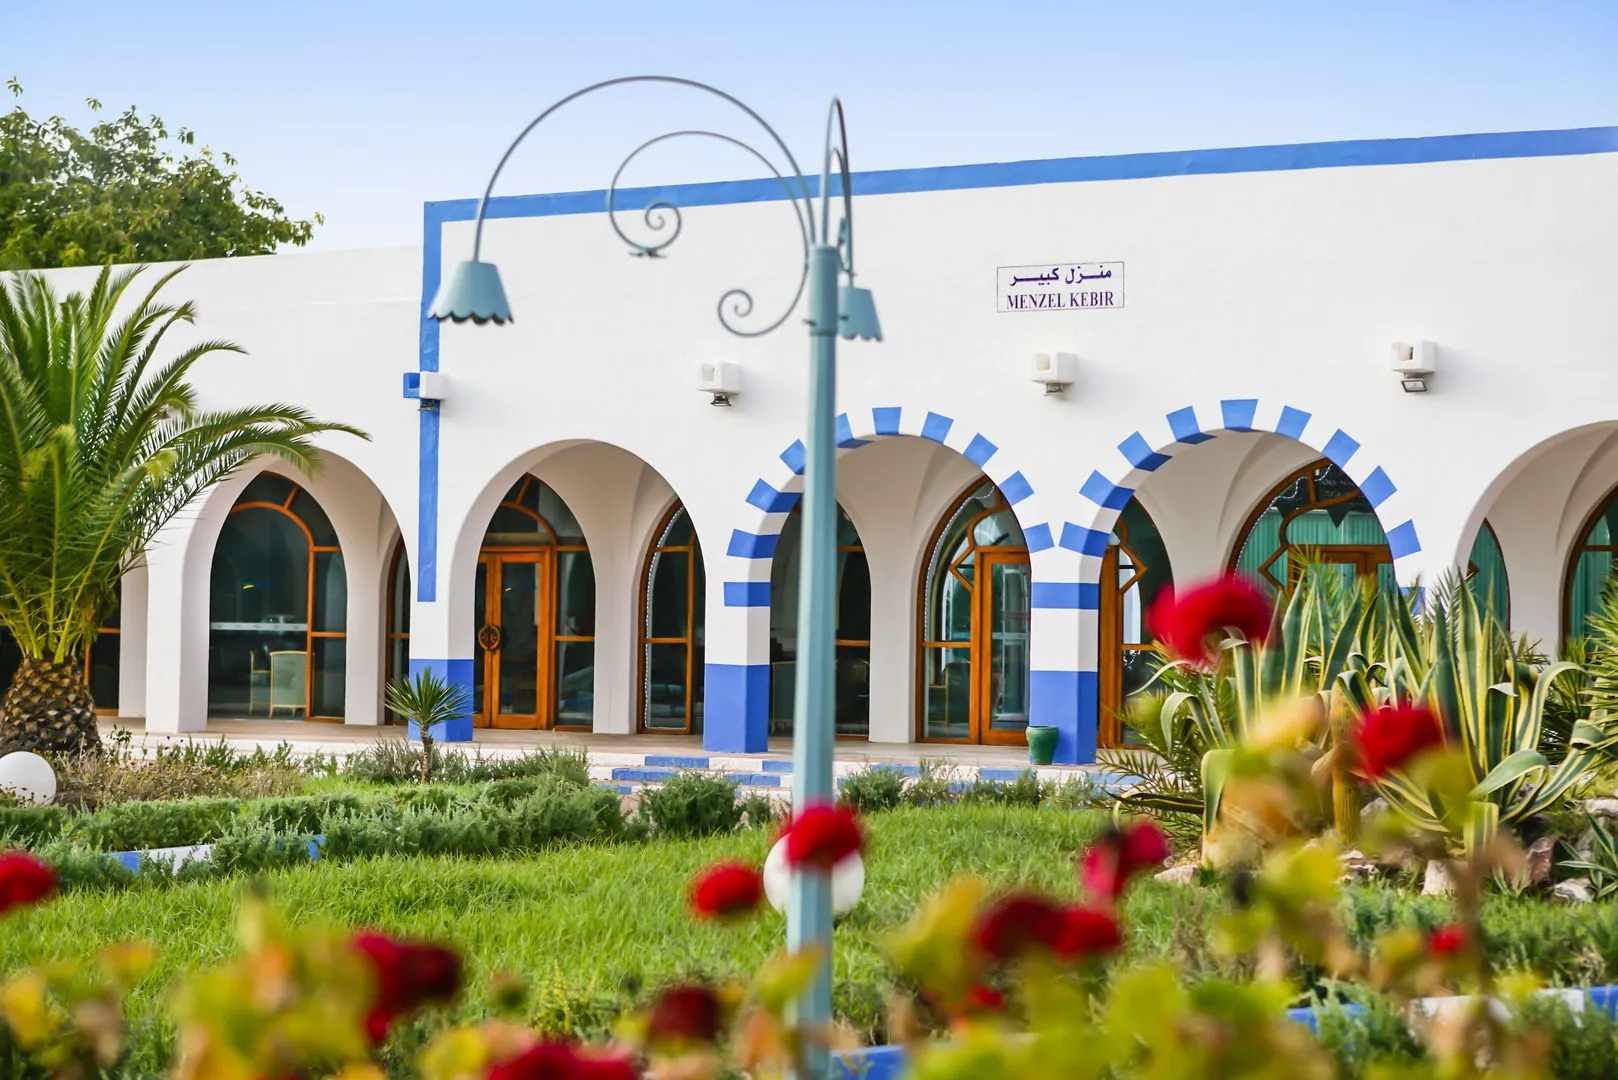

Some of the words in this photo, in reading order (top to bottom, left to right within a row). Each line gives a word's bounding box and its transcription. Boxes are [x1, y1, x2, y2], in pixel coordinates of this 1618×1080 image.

[1009, 267, 1059, 286] كبير
[1065, 265, 1112, 285] منزل
[1007, 293, 1065, 309] MENZEL
[1070, 291, 1114, 308] KEBIR
